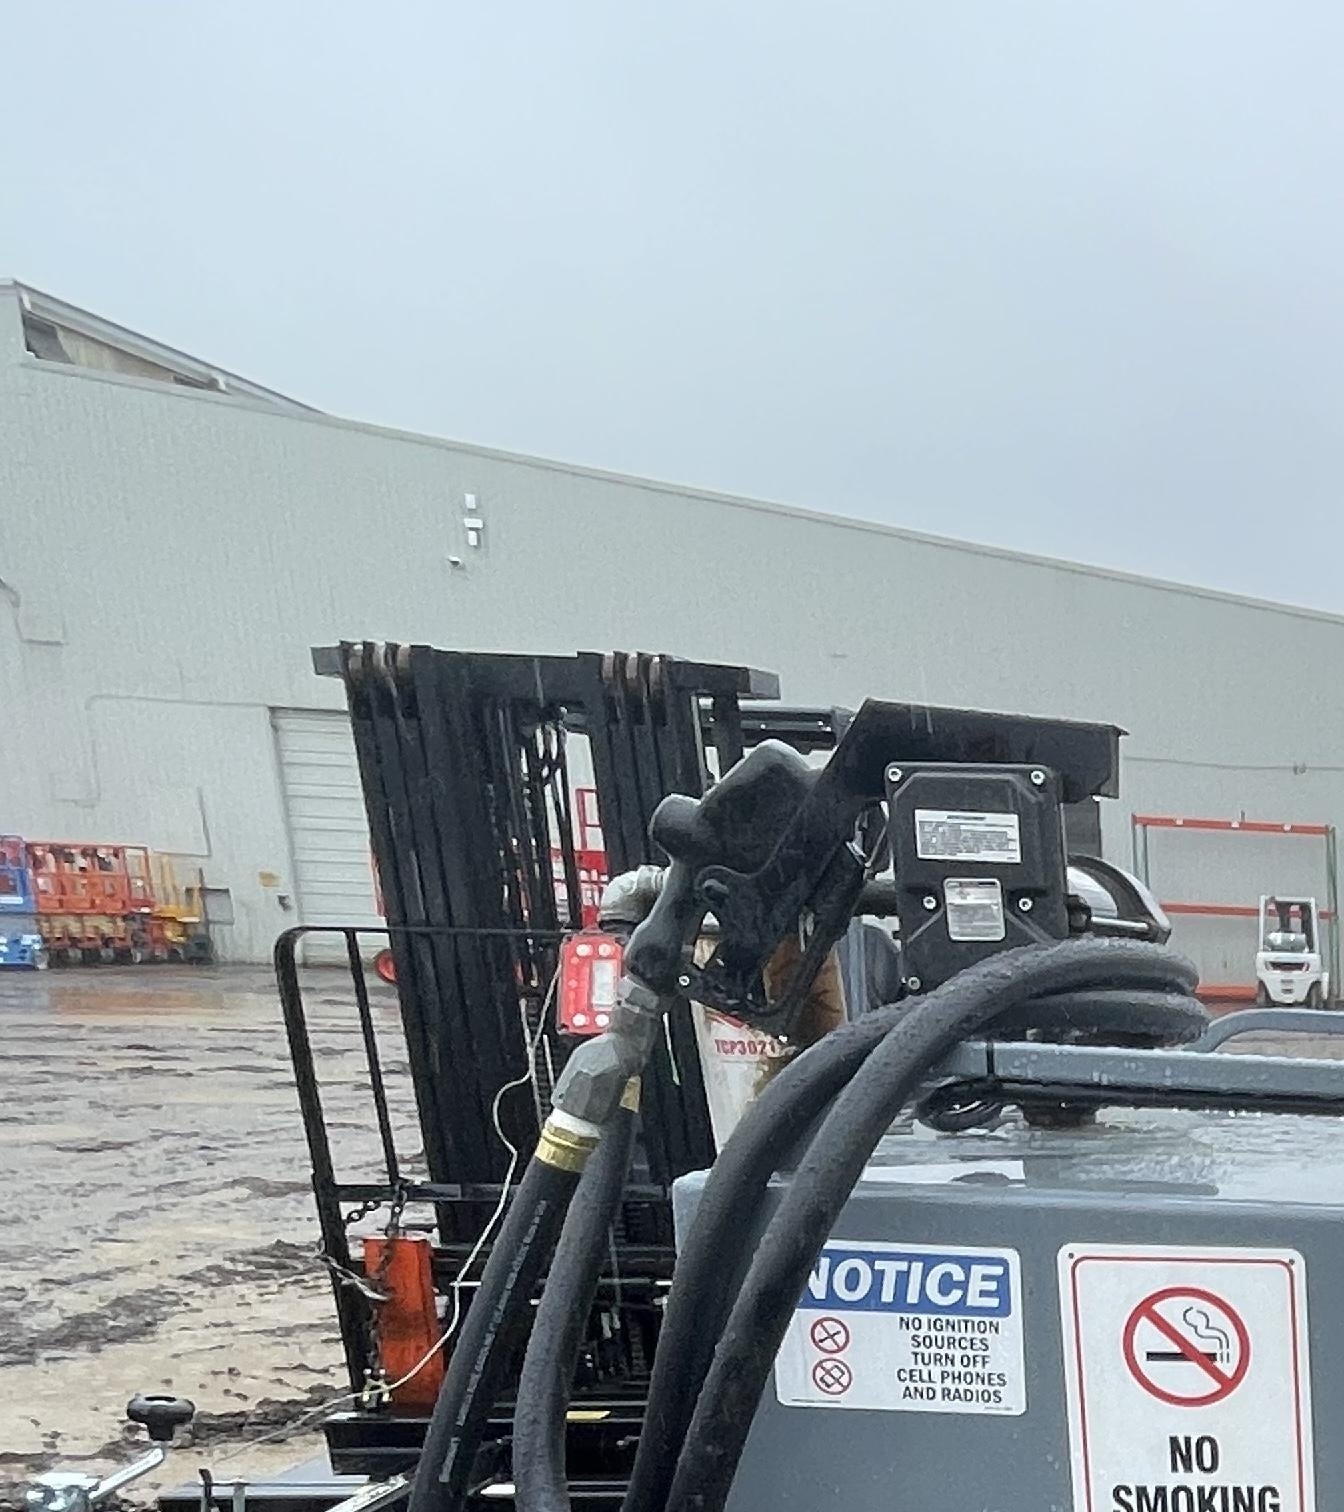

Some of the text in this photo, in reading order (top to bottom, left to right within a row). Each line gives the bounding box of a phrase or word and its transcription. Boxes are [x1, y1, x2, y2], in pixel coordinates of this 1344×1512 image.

[808, 1256, 1004, 1308] NOTICE
[900, 1316, 1000, 1335] NO IGNITION
[911, 1335, 989, 1351] SOURCES
[911, 1352, 991, 1369] TURN OFF
[897, 1369, 1007, 1387] CELL PHONES
[902, 1386, 1002, 1404] AND RADIOS
[1169, 1435, 1220, 1474] NO
